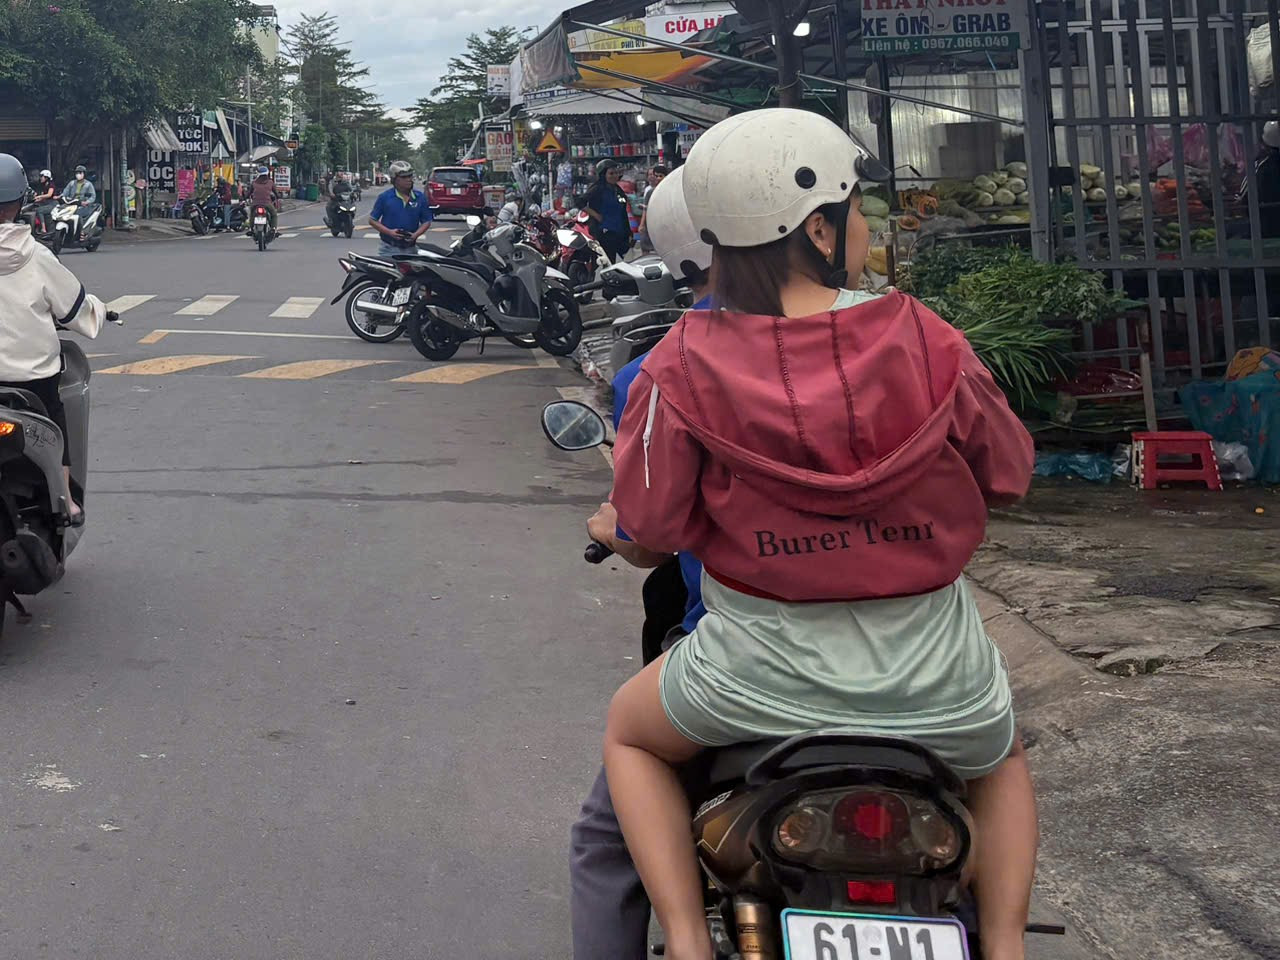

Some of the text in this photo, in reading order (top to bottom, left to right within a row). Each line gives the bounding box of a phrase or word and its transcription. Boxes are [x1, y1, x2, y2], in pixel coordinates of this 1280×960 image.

[665, 15, 699, 34] CỬA
[861, 17, 888, 37] XE
[895, 12, 930, 36] ÔM
[952, 13, 1011, 34] GRAB
[864, 38, 892, 52] Liên
[894, 39, 910, 51] hệ
[921, 35, 1010, 50] 0967.066.049
[149, 163, 174, 180] ÓC
[753, 529, 851, 558] Burer
[813, 921, 935, 960] 61-N1
